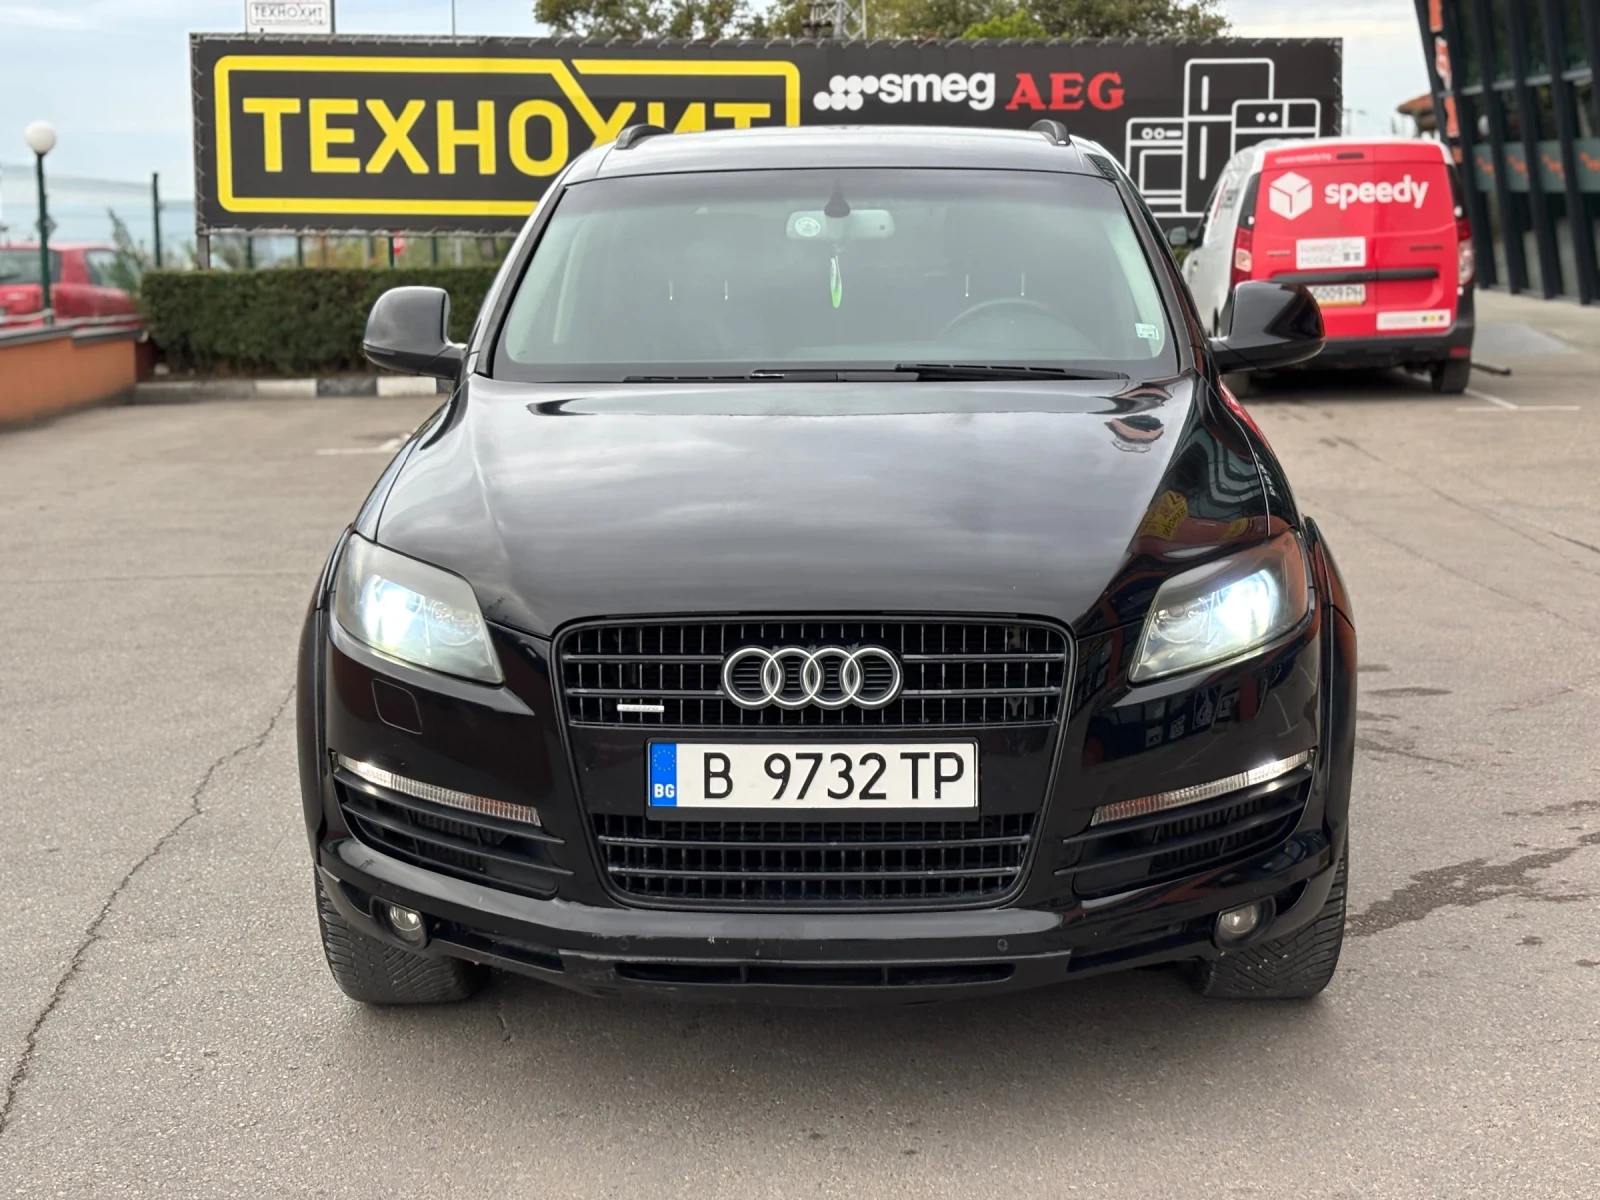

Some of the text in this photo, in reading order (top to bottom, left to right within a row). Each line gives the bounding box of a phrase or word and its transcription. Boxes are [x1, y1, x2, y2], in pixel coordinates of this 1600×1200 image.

[254, 6, 323, 17] ТЕХНОХИТ
[878, 72, 1125, 111] smeg AEG
[1324, 174, 1429, 210] speedy
[654, 783, 675, 799] BG
[703, 752, 965, 800] B 9732 TP
